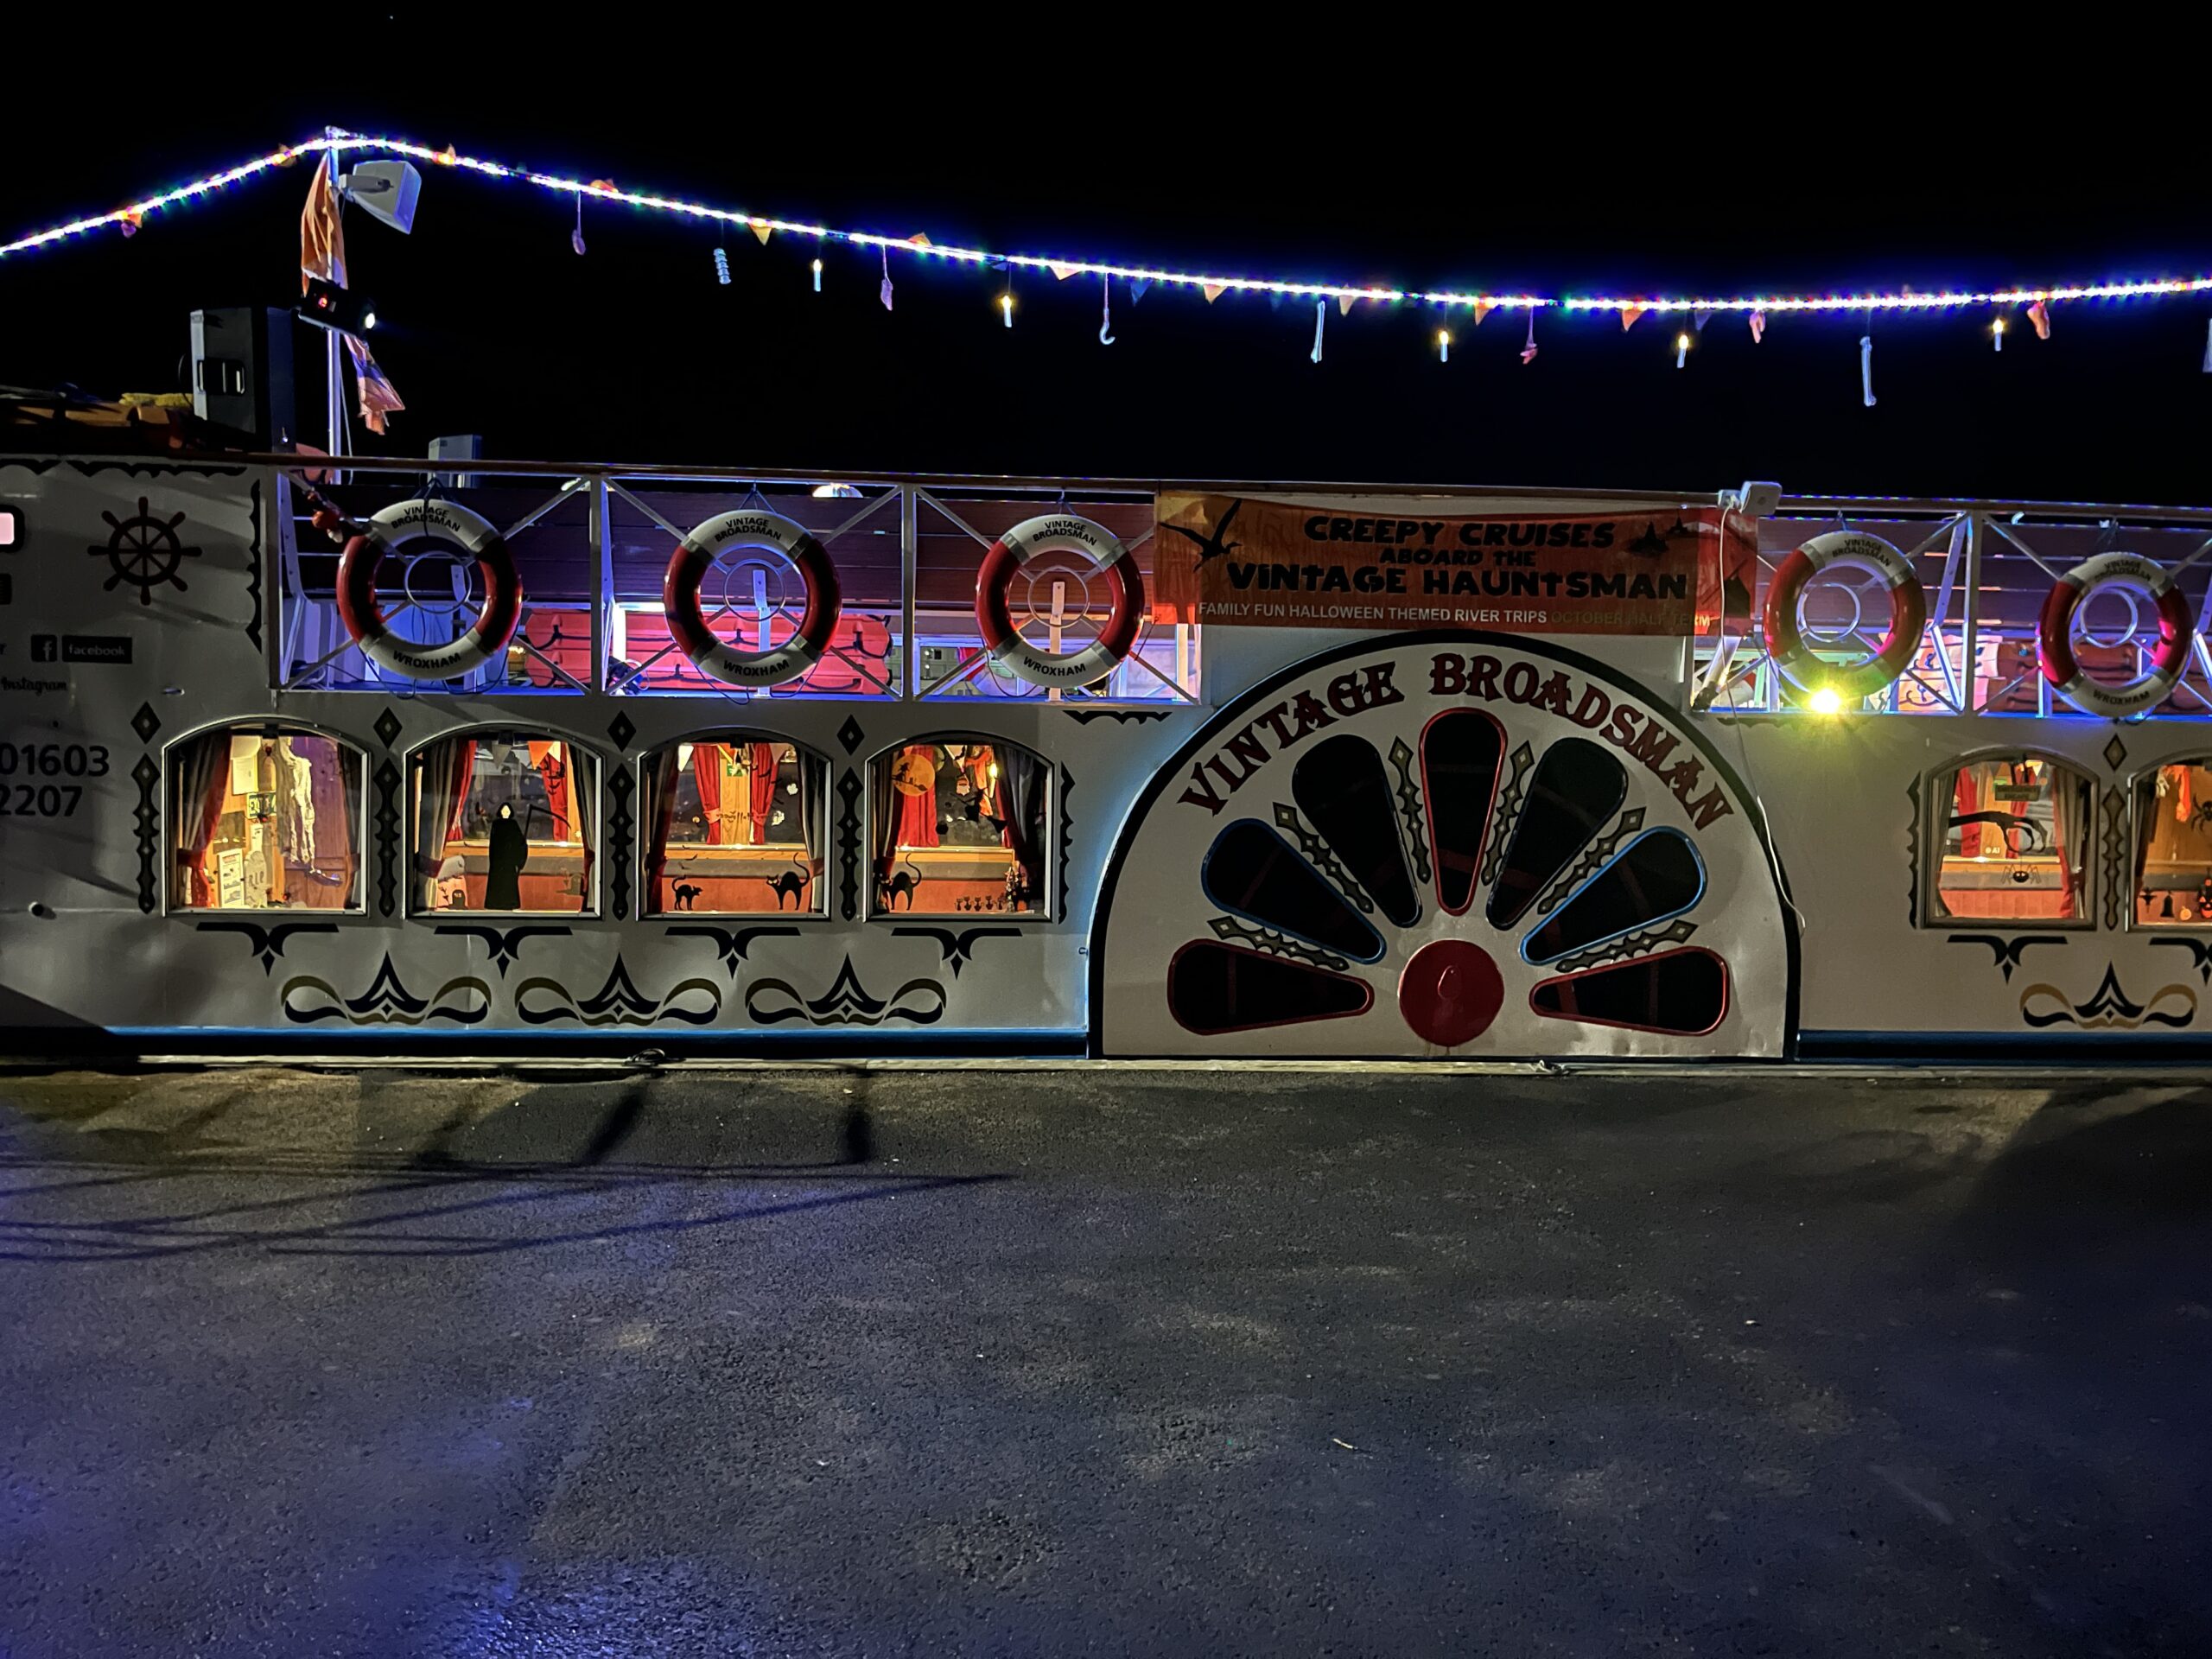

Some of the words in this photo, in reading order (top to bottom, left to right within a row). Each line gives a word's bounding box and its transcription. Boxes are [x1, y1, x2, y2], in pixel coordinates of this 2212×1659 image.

[726, 517, 770, 528] VINTAGE
[1045, 520, 1086, 532] VINTAGE
[1305, 516, 1445, 544] CREEPY
[1459, 522, 1616, 548] CRUISES
[715, 524, 781, 543] BROADSMAN
[1033, 528, 1096, 546] BROADSMAN
[1380, 548, 1483, 567] ABOARD
[1493, 550, 1535, 567] THE
[1227, 563, 1407, 594] VINTAGE
[1423, 569, 1687, 599] HAUNTSMAN
[1198, 602, 1253, 617] FAMILY
[1255, 604, 1287, 617] FUN
[1290, 606, 1383, 620] HALLOWEEN
[1389, 607, 1451, 621] THEMED
[1454, 609, 1500, 622] RIVER
[1504, 610, 1547, 623] TRIPS
[1551, 611, 1624, 624] OCTOBER
[68, 643, 125, 658] facebook
[392, 651, 461, 669] WROXHAM
[723, 659, 789, 677] WROXHAM
[1023, 657, 1086, 677] WROXHAM
[1, 677, 67, 697] Instagram
[2093, 690, 2150, 705] WROXHAM
[1178, 661, 1406, 818] VINTAGE
[1428, 652, 1735, 833] BROADSMAN
[0, 742, 110, 777] 01603
